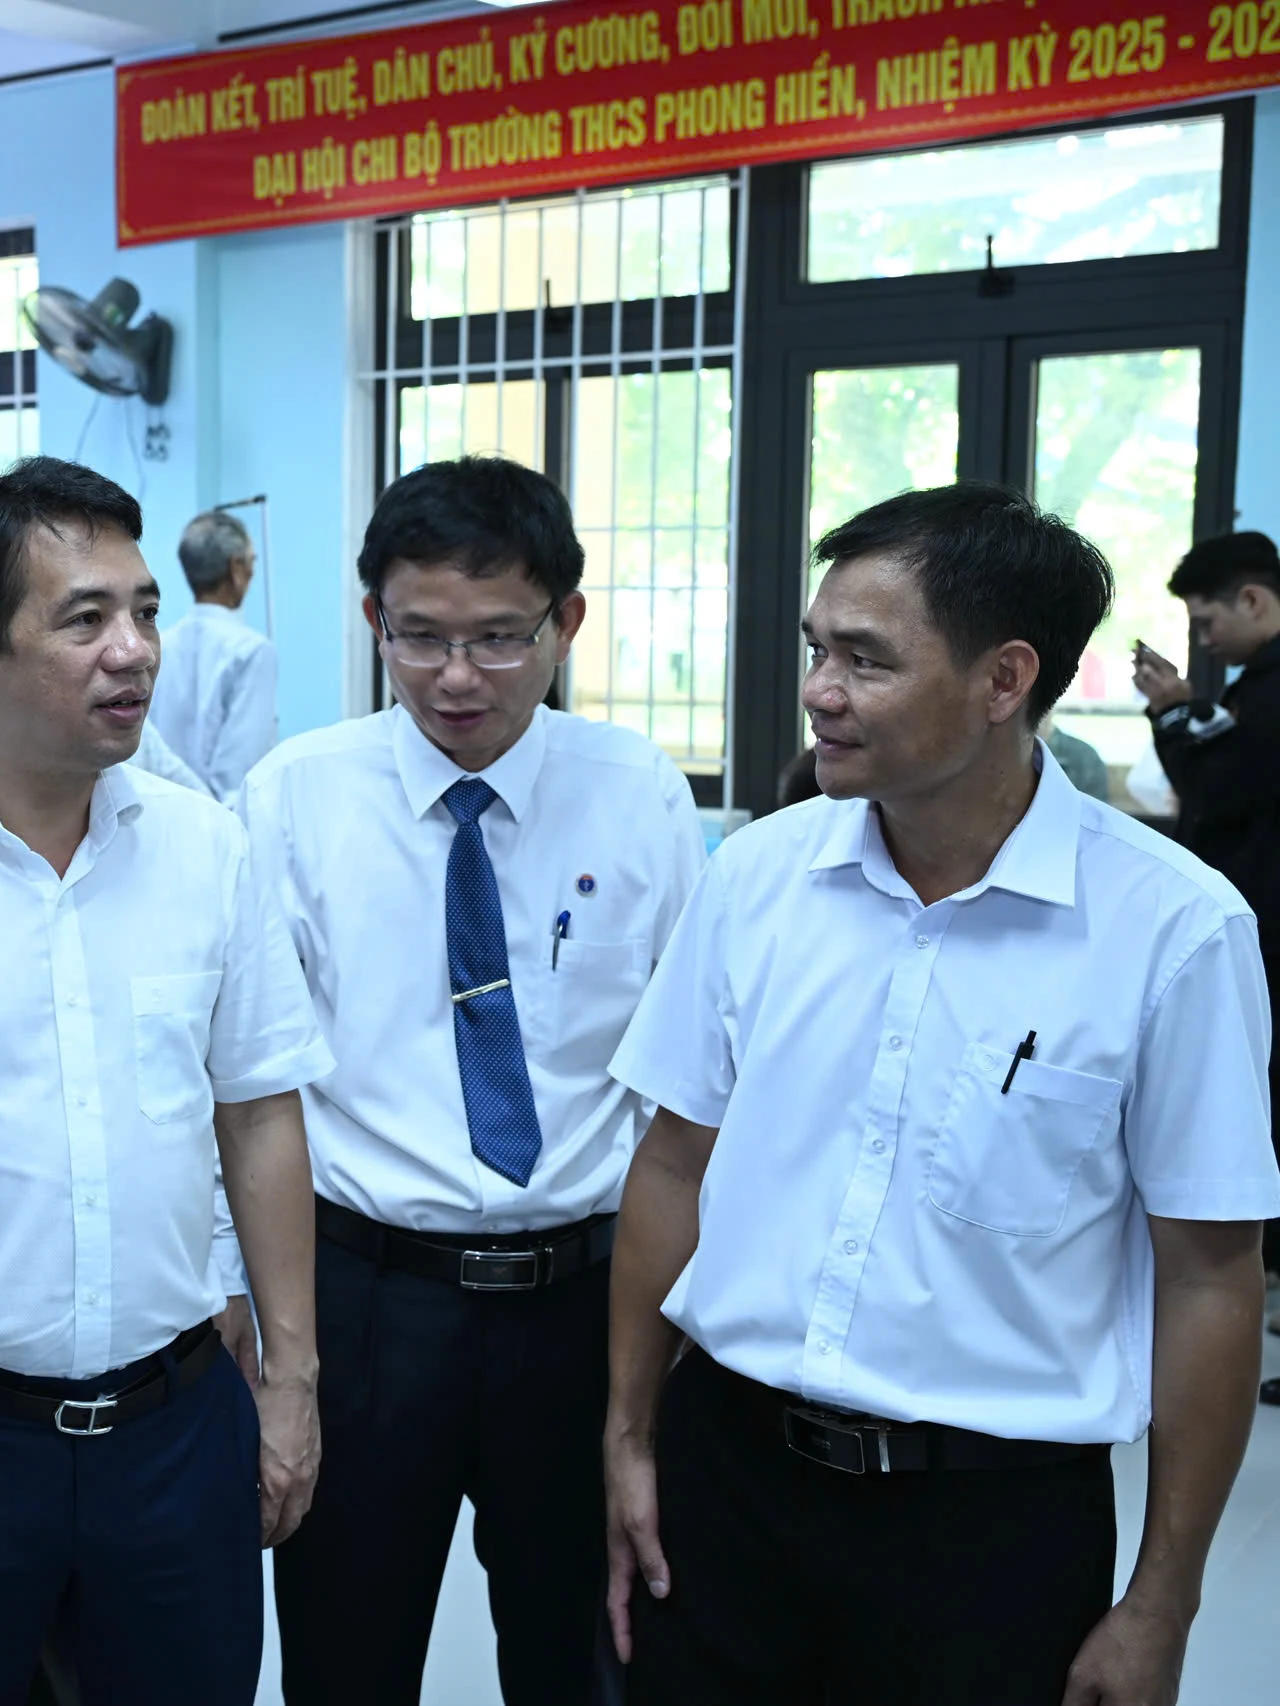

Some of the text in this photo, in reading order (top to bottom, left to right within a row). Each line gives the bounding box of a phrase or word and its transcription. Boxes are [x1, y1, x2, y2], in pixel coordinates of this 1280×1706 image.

[141, 87, 206, 144] ĐOÀN
[211, 71, 260, 132] KẾT,
[265, 65, 306, 122] TRÍ
[311, 56, 368, 120] TUỆ,
[373, 46, 429, 106] DÂN
[437, 25, 503, 95] CHỦ,
[509, 16, 548, 84] KỶ
[555, 11, 670, 76] CƯƠNG,
[253, 151, 296, 206] ĐẠI
[302, 136, 346, 199] HỘI
[352, 136, 398, 186] CHI
[404, 119, 441, 186] BỘ
[448, 104, 562, 172] TRƯỜNG
[569, 96, 646, 155] THCS
[654, 77, 765, 143] PHONG
[875, 36, 997, 113] NHIỆM
[1007, 20, 1058, 92] KỲ
[1067, 15, 1167, 83] 2025
[1206, 1, 1280, 63] 202
